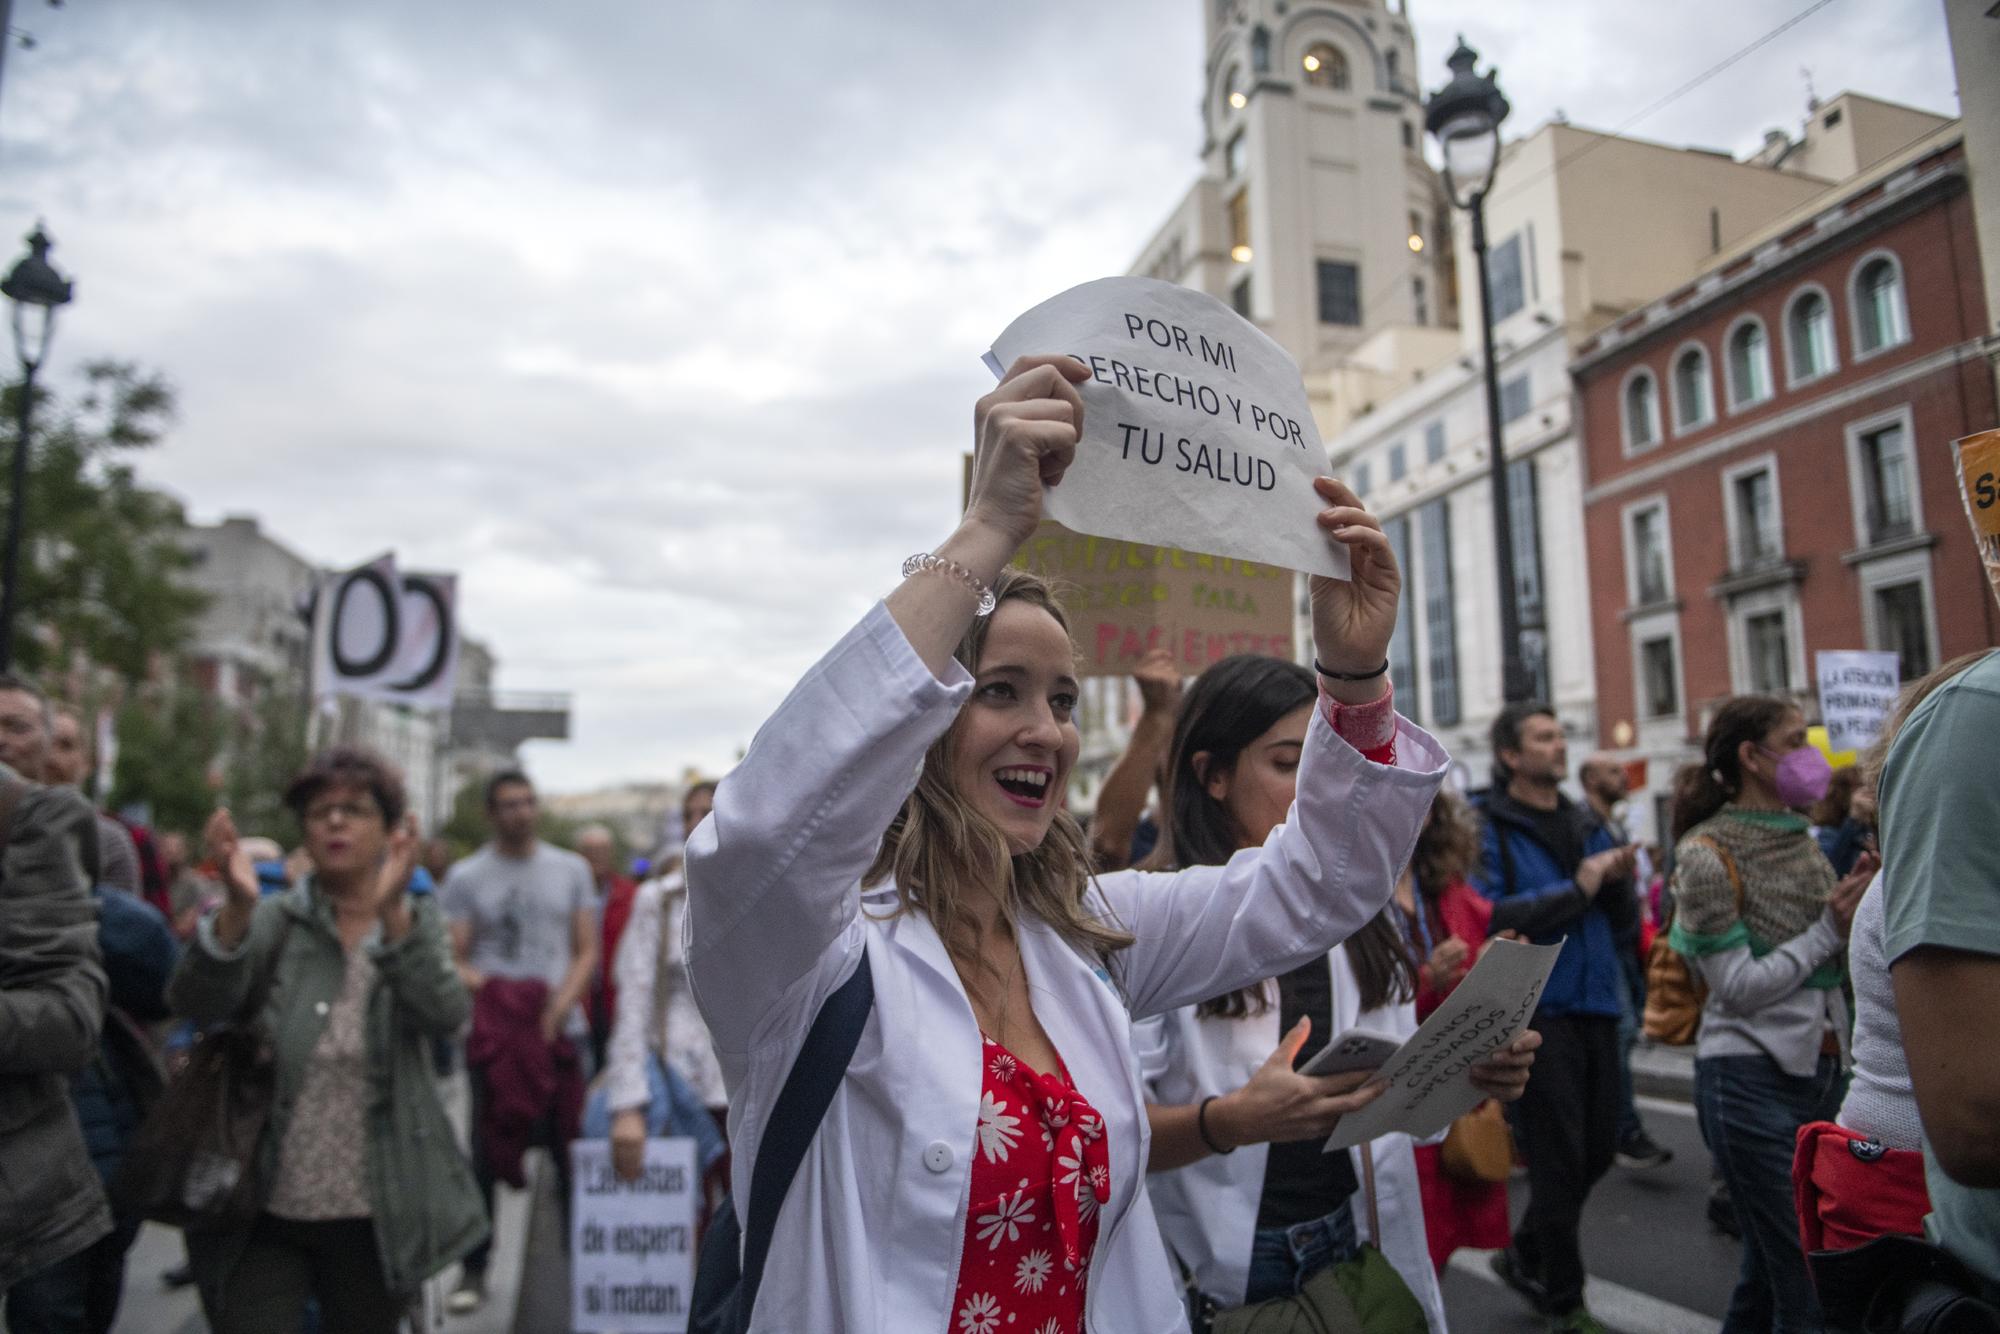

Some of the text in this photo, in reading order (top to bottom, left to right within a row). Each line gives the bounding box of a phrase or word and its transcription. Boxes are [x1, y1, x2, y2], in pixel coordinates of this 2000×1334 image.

[1124, 313, 1237, 373] POR MI
[1226, 393, 1242, 424] Y
[1251, 404, 1306, 450] POR
[1117, 422, 1277, 492] TU SALUD
[1975, 472, 2000, 510] S
[1406, 1008, 1507, 1089] CUIDADOS
[1422, 1003, 1482, 1049] UNOS
